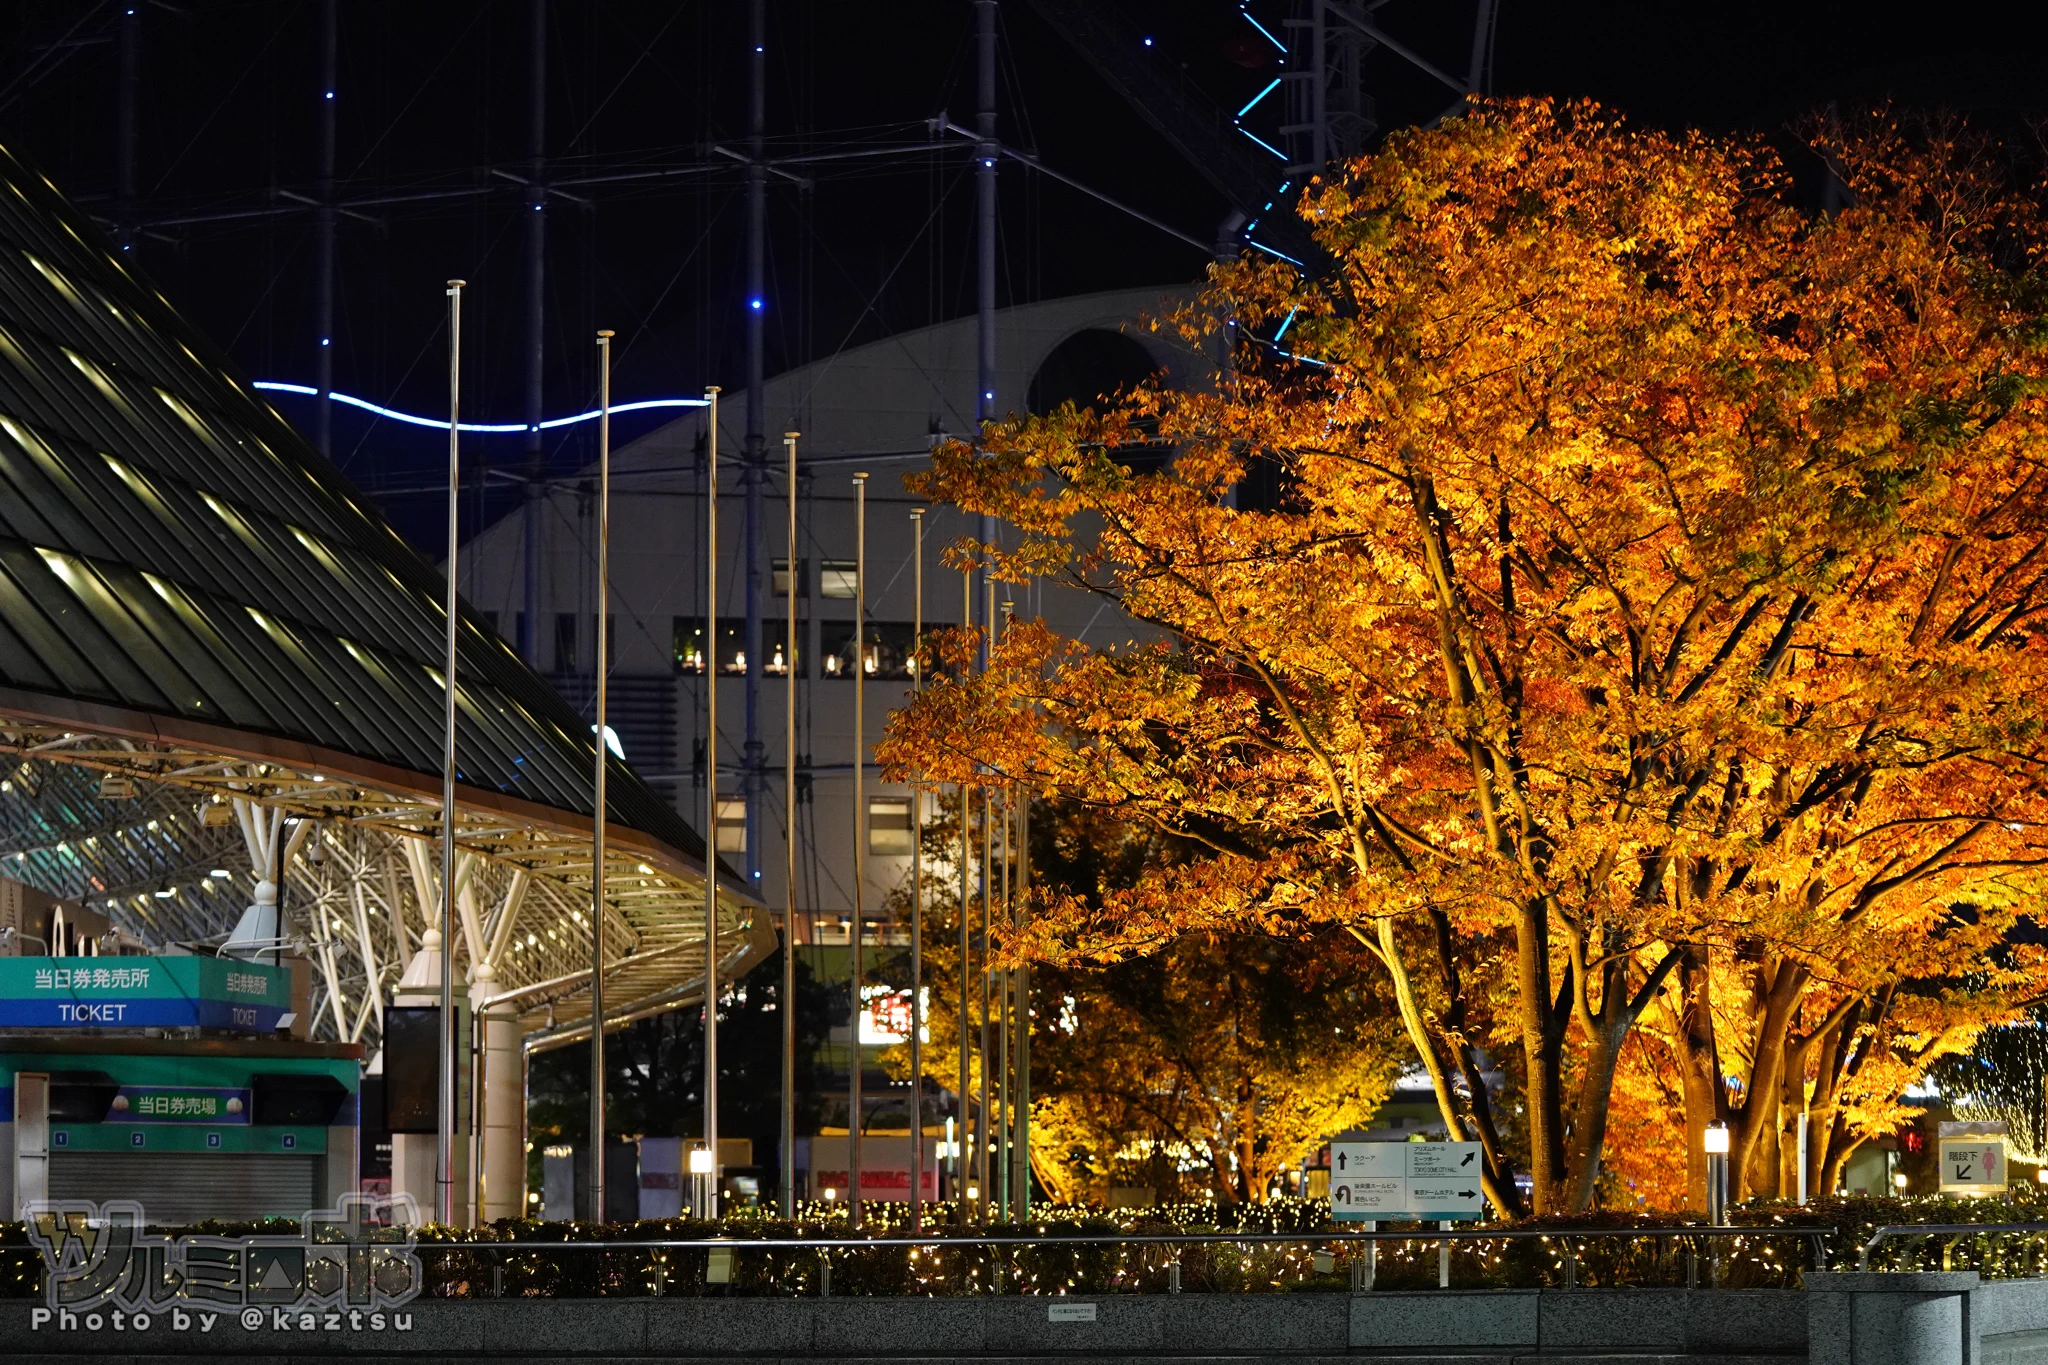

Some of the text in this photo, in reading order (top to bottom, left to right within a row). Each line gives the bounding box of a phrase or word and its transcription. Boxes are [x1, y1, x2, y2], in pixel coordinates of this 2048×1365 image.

[34, 968, 150, 989] 当日券発売所
[226, 972, 268, 995] 当日券発売所
[58, 1004, 127, 1021] TICKET
[232, 1008, 258, 1026] TICKET
[138, 1097, 217, 1115] 当日券売場
[1949, 1152, 1978, 1161] 階段下
